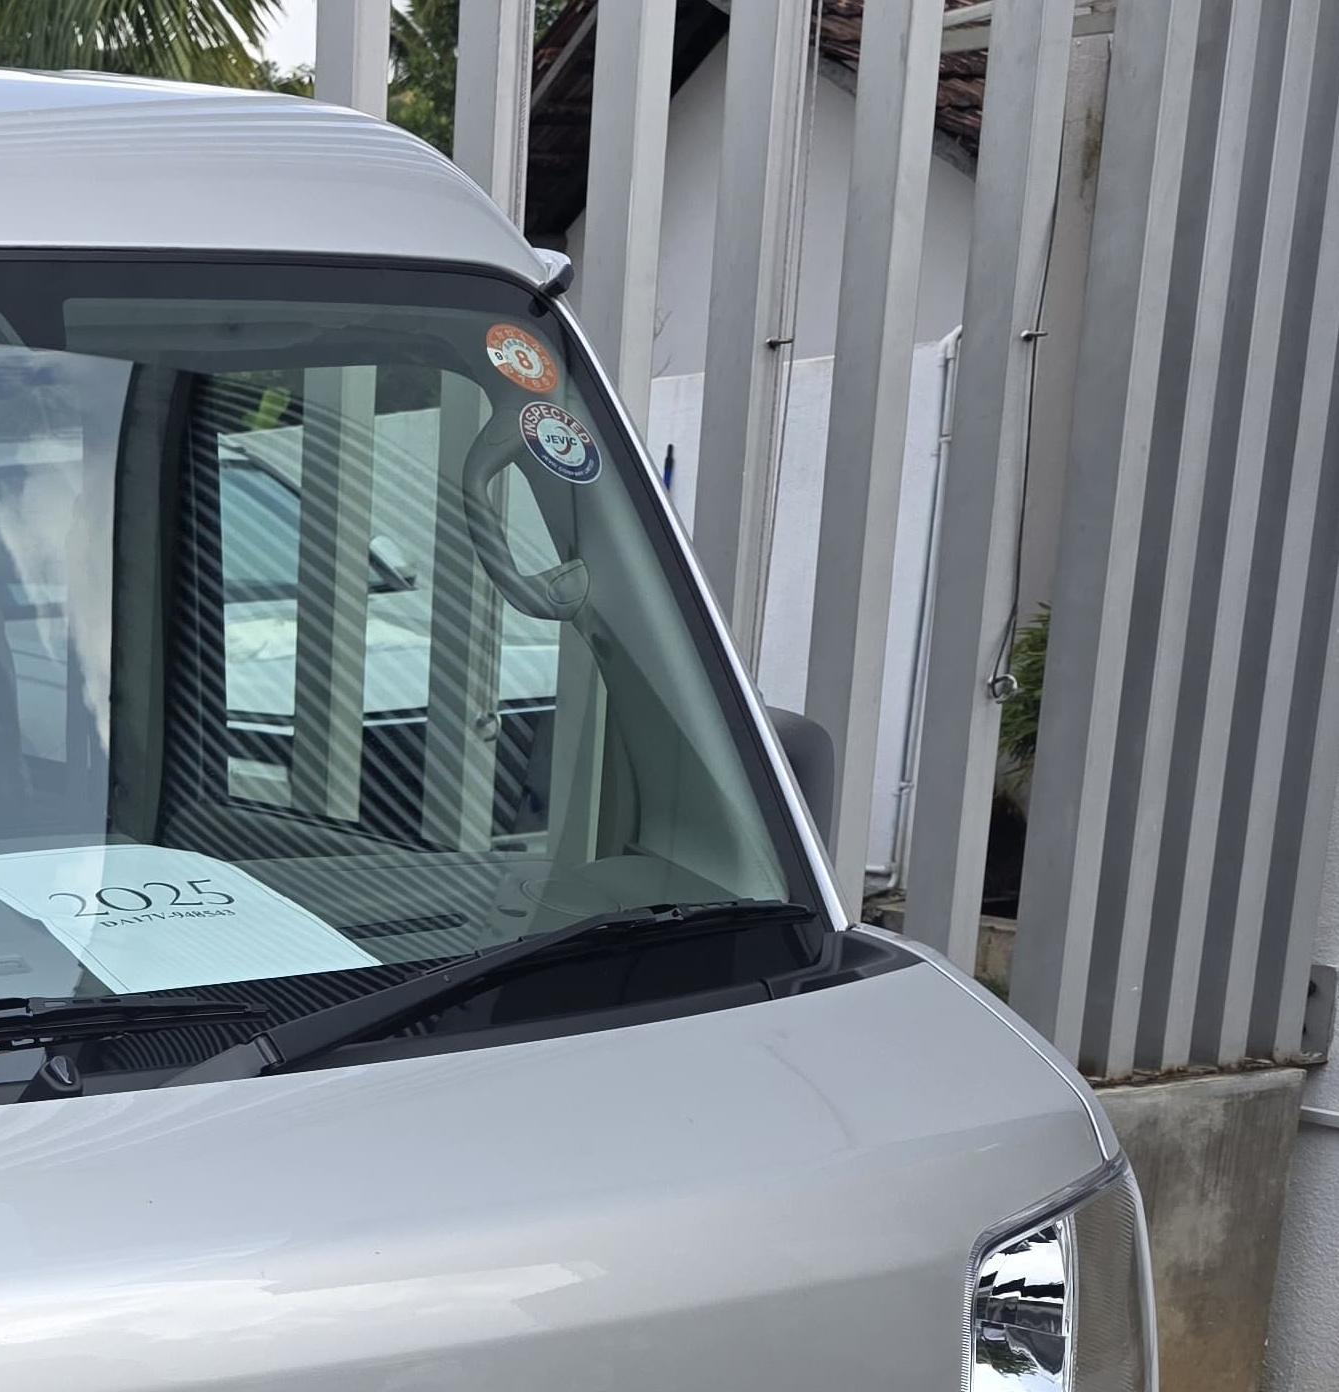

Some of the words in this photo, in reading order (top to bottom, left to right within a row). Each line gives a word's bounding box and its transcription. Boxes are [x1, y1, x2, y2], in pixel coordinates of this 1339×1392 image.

[515, 349, 534, 370] 8
[524, 405, 591, 443] INSPECTED
[545, 435, 578, 446] JEVIC
[49, 880, 235, 917] 2025
